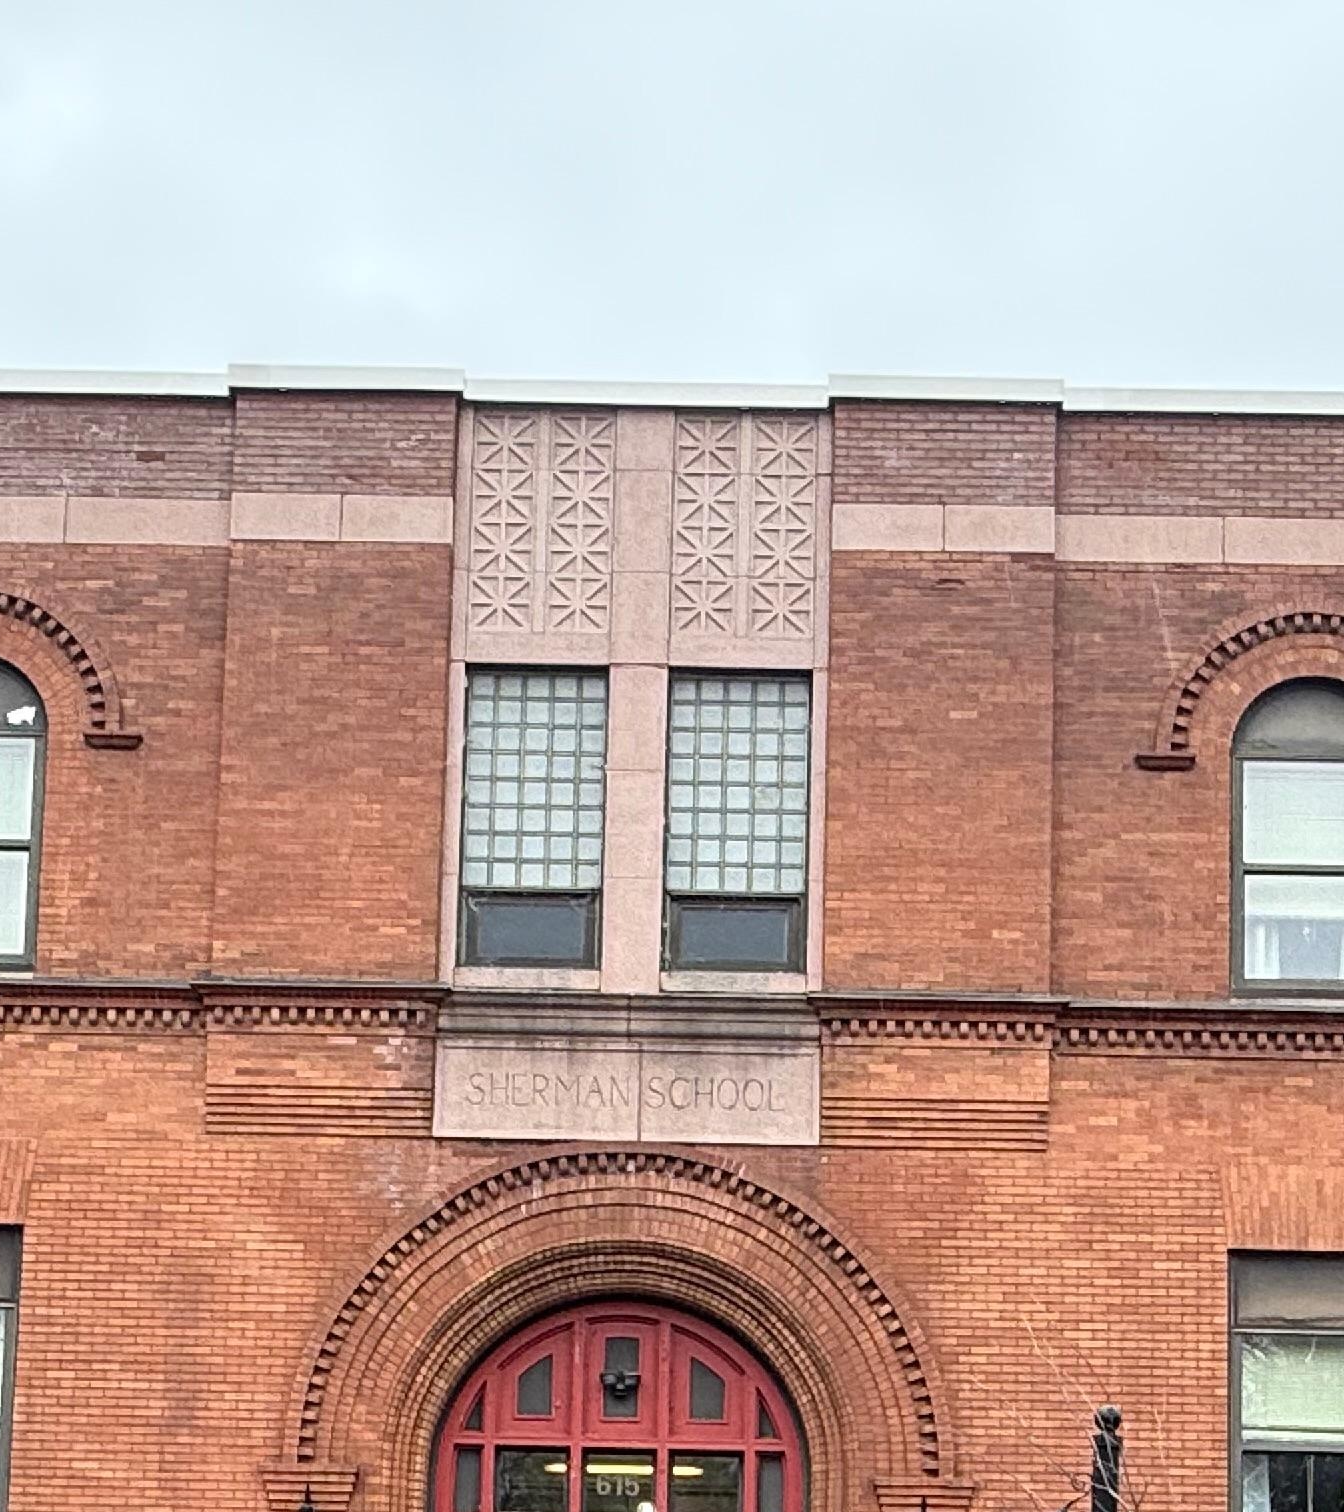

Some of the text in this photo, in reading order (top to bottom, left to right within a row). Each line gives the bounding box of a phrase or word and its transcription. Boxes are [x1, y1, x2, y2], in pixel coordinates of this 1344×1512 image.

[467, 1071, 786, 1112] SHERMAN SCHOOL
[596, 1475, 639, 1496] 615
